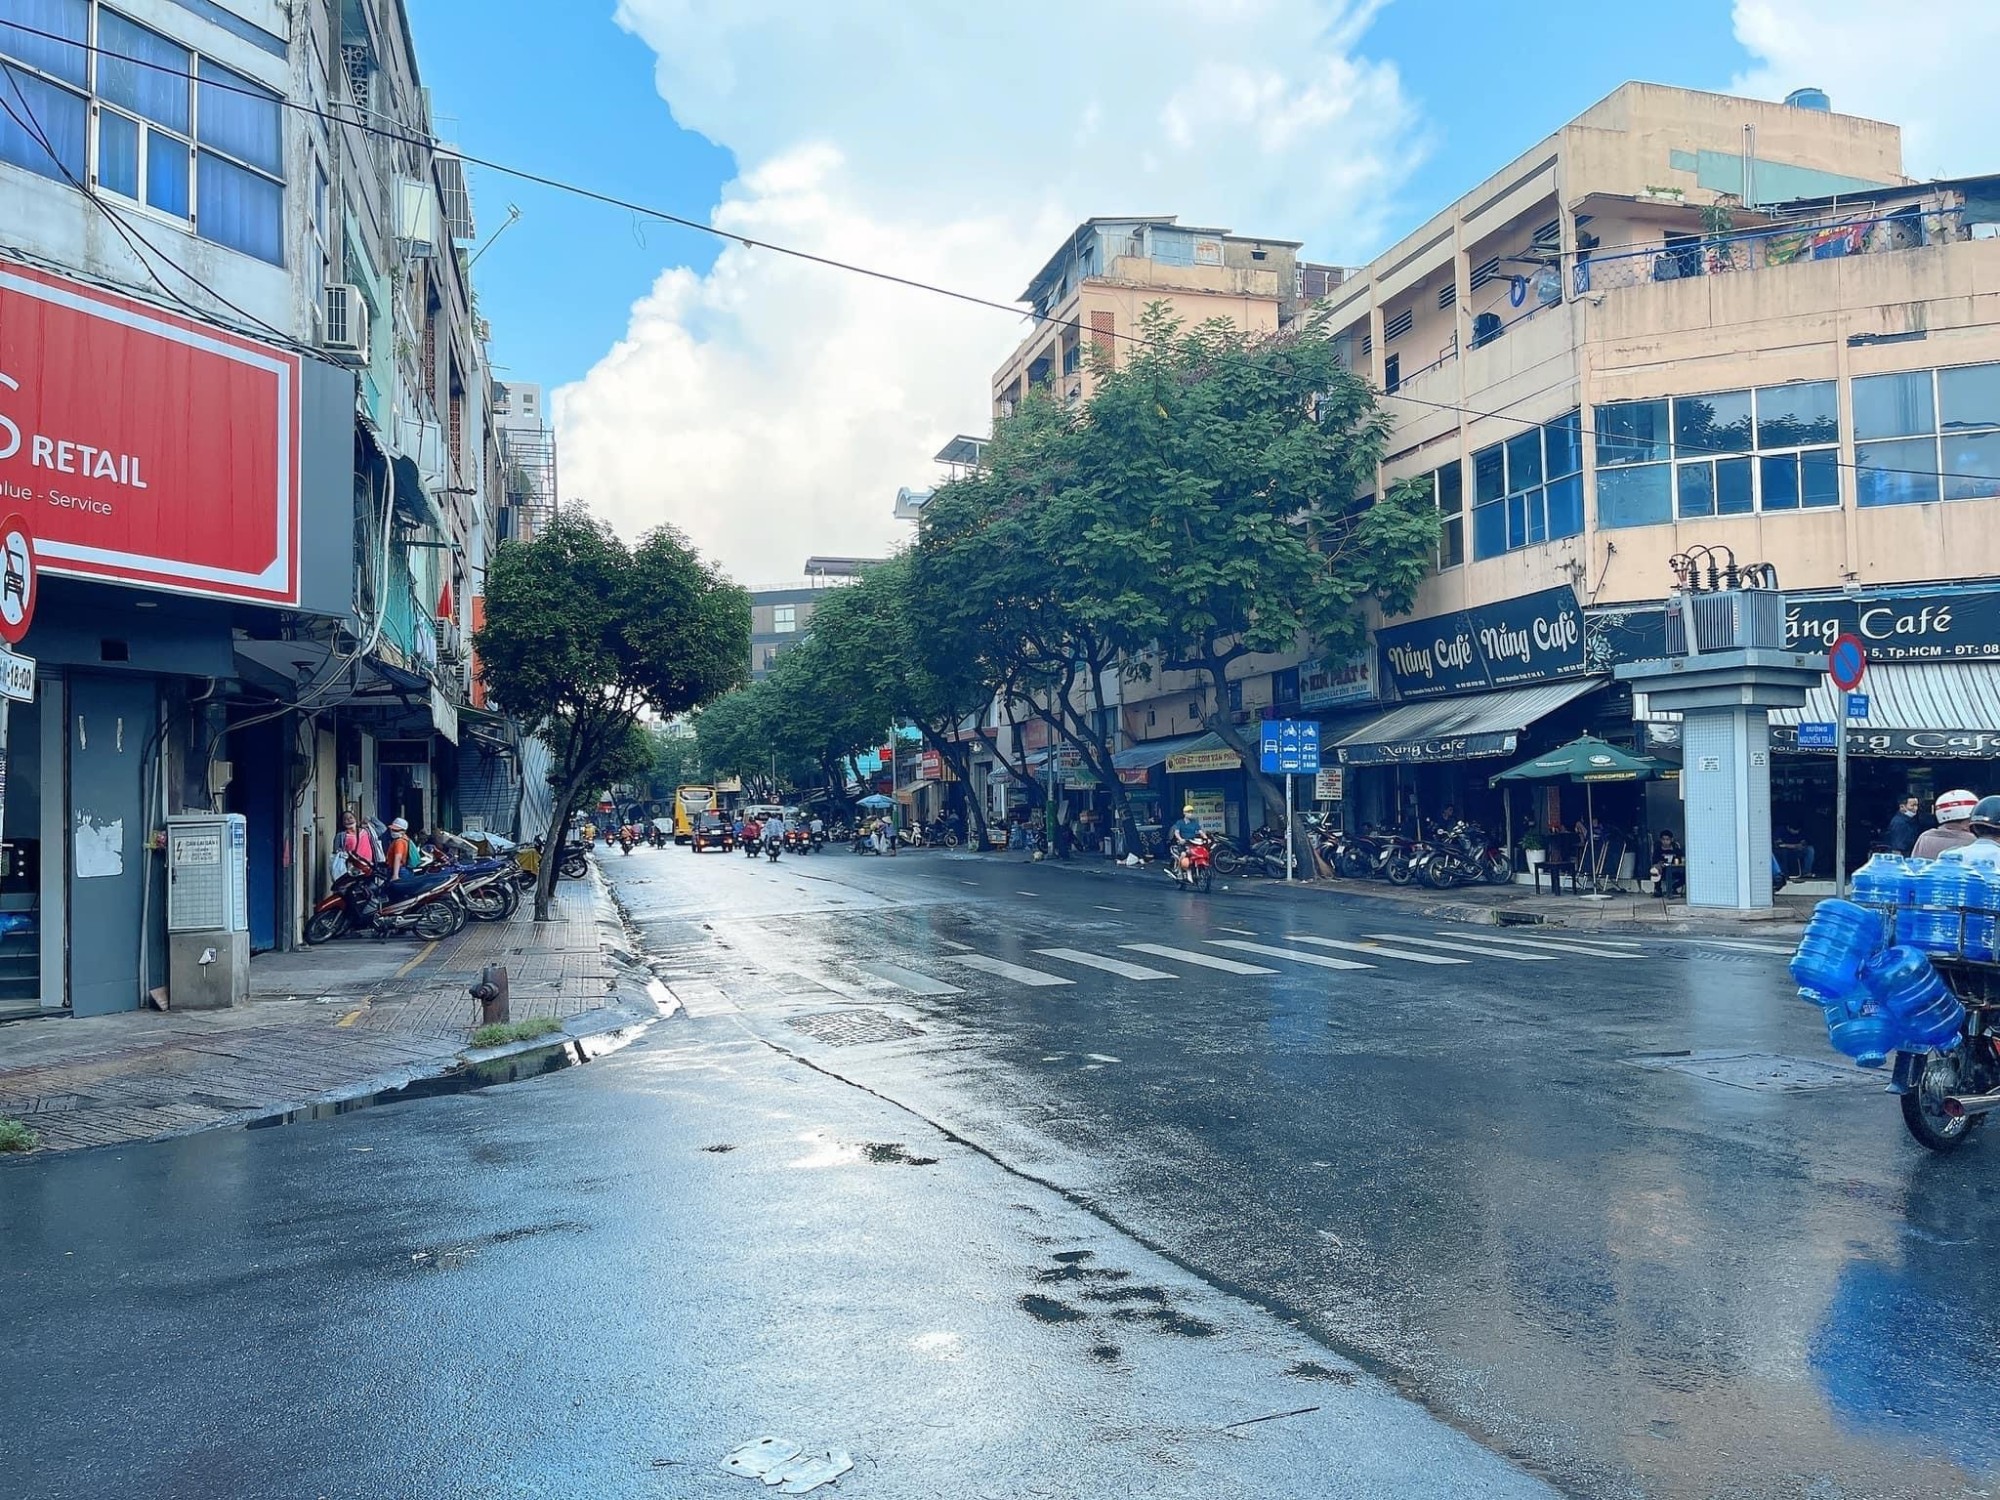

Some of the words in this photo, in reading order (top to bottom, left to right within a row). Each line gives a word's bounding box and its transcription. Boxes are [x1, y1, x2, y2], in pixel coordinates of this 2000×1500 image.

[32, 434, 147, 488] RETAIL
[48, 489, 112, 515] Service
[1480, 622, 1531, 663] Nắng
[1532, 611, 1579, 652] Café
[1785, 608, 1839, 647] ắng
[1860, 605, 1952, 639] Café
[1388, 642, 1432, 679] Nắng
[1434, 633, 1473, 670] Café
[1888, 646, 1941, 659] Tp.HCM
[1955, 644, 1979, 655] ĐT:
